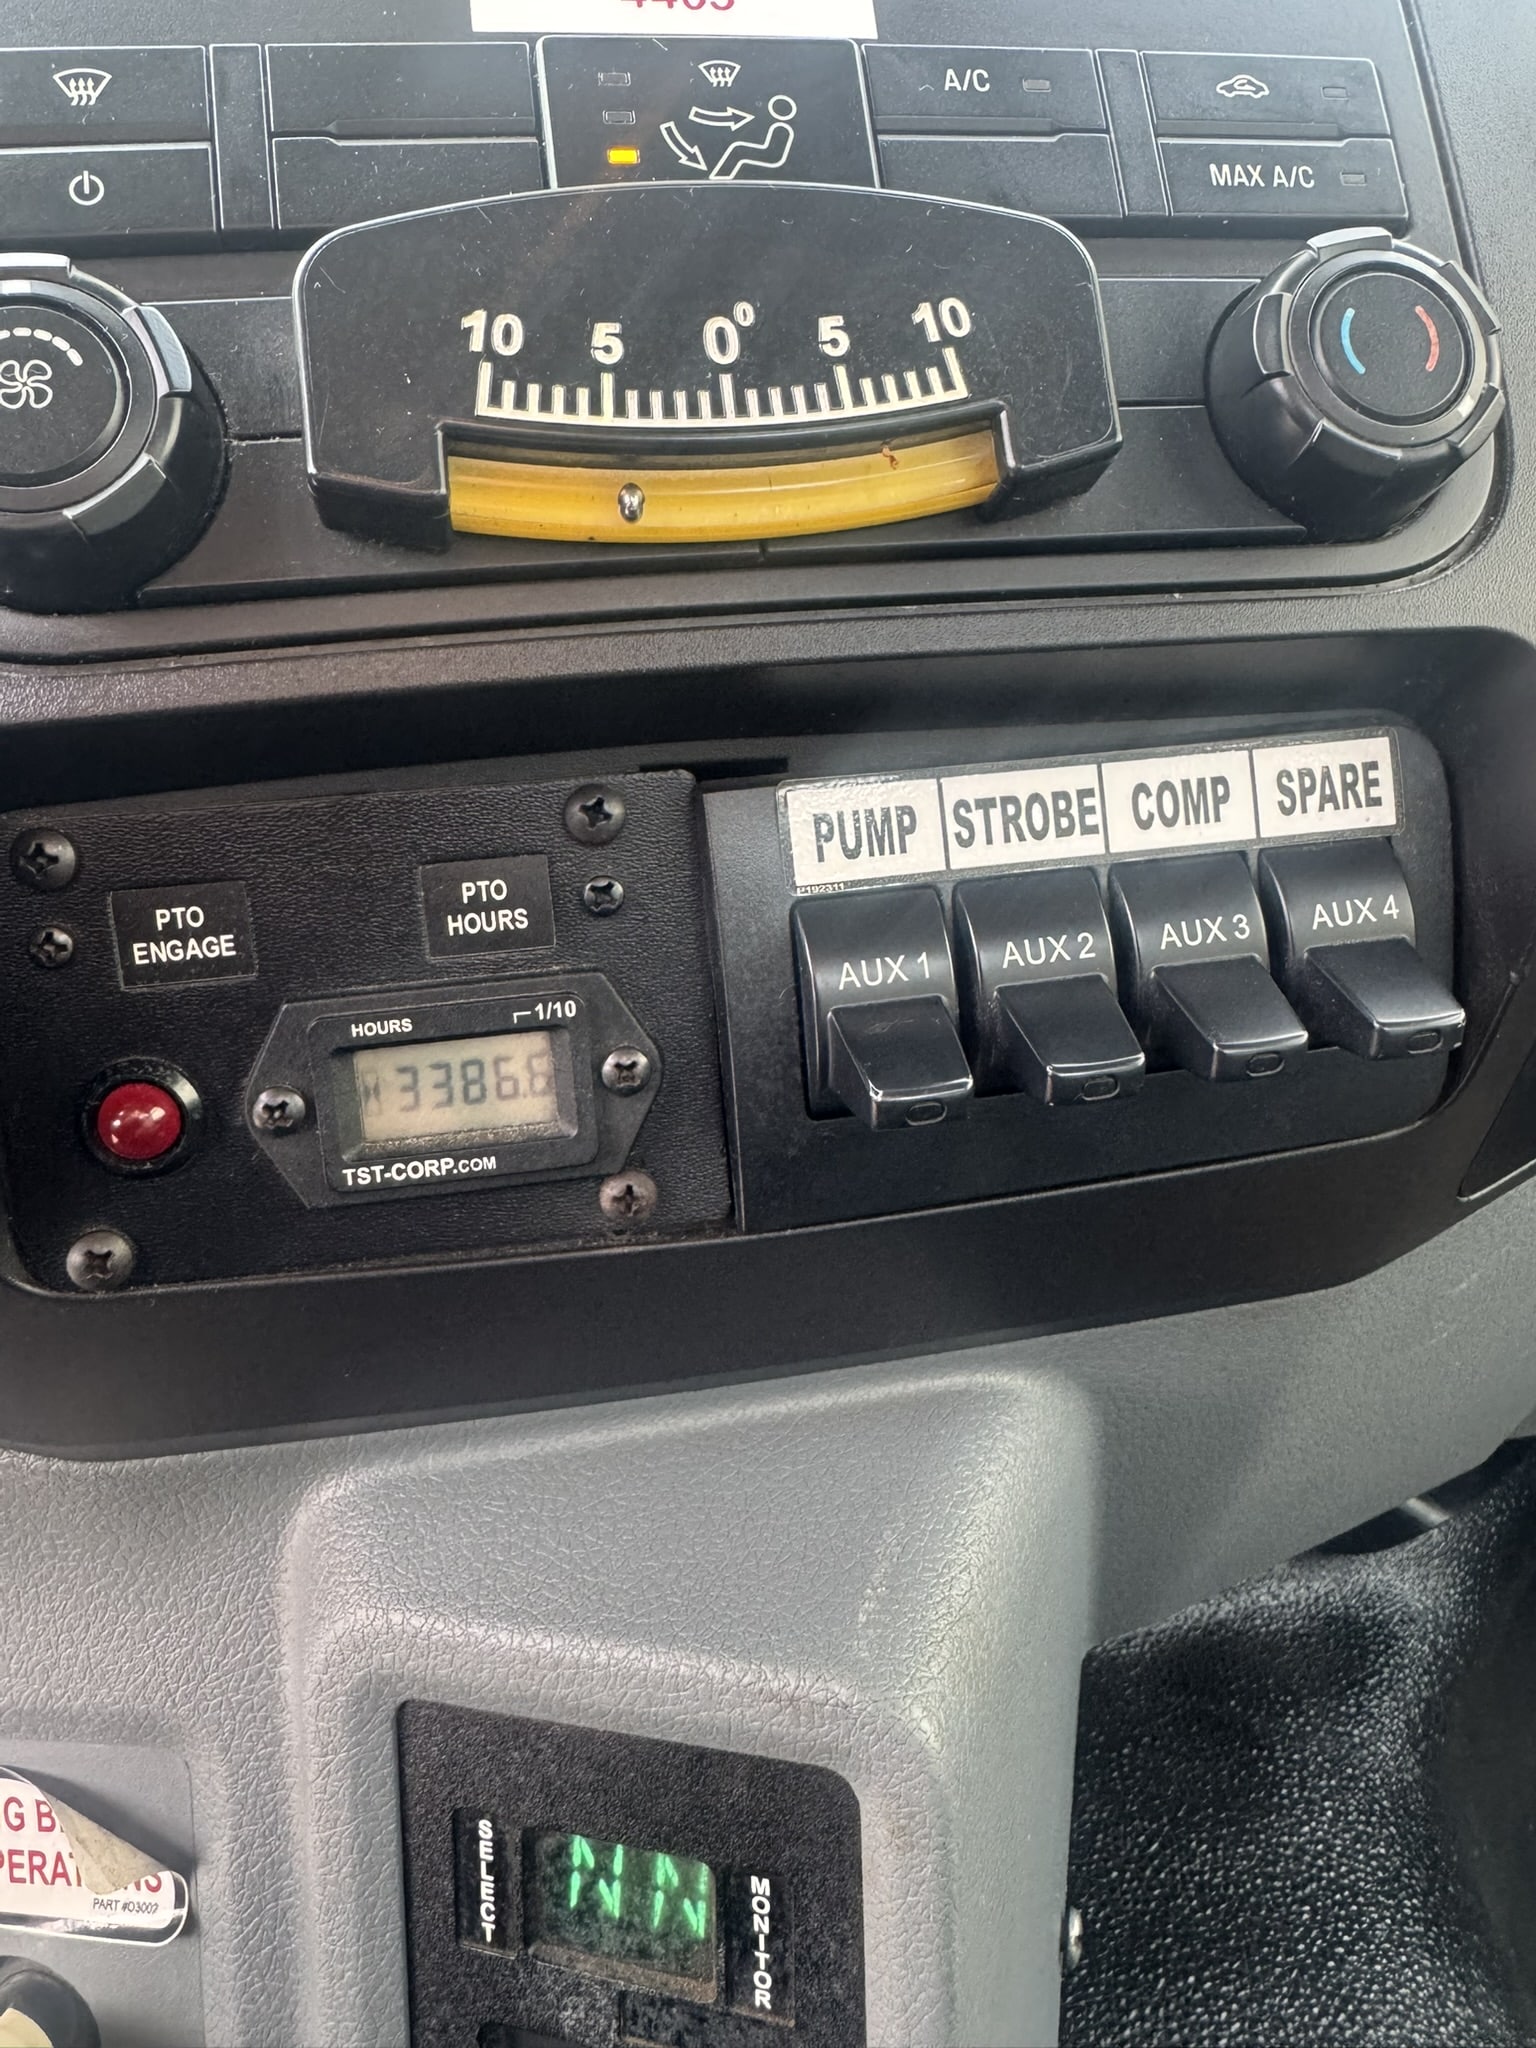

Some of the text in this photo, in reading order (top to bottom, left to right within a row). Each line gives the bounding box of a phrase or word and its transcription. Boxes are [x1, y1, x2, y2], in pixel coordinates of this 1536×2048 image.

[943, 68, 991, 93] A/C
[1209, 163, 1316, 189] MAX A/C
[460, 308, 525, 357] 10
[817, 315, 851, 357] 5
[911, 296, 972, 343] 10
[590, 321, 625, 366] 5
[1132, 775, 1232, 831] COMP
[1276, 760, 1384, 817] SPARE
[813, 804, 918, 862] PUMP
[952, 786, 1100, 849] STROBE
[461, 879, 508, 905] PTO
[154, 906, 206, 931] PTO
[446, 908, 530, 937] HOURS
[1311, 894, 1401, 931] AUX 4
[132, 934, 238, 966] ENGAGE
[1001, 932, 1097, 970] AUX 2
[1159, 913, 1251, 951] AUX 3
[838, 953, 929, 991] AUX 1
[350, 1018, 414, 1038] HOURS
[534, 1000, 577, 1021] 1/10
[341, 1155, 497, 1187] TST-CORP.COM
[477, 1818, 496, 1943] SELECT
[92, 1897, 120, 1912] PART
[749, 1874, 773, 2010] MONITOR
